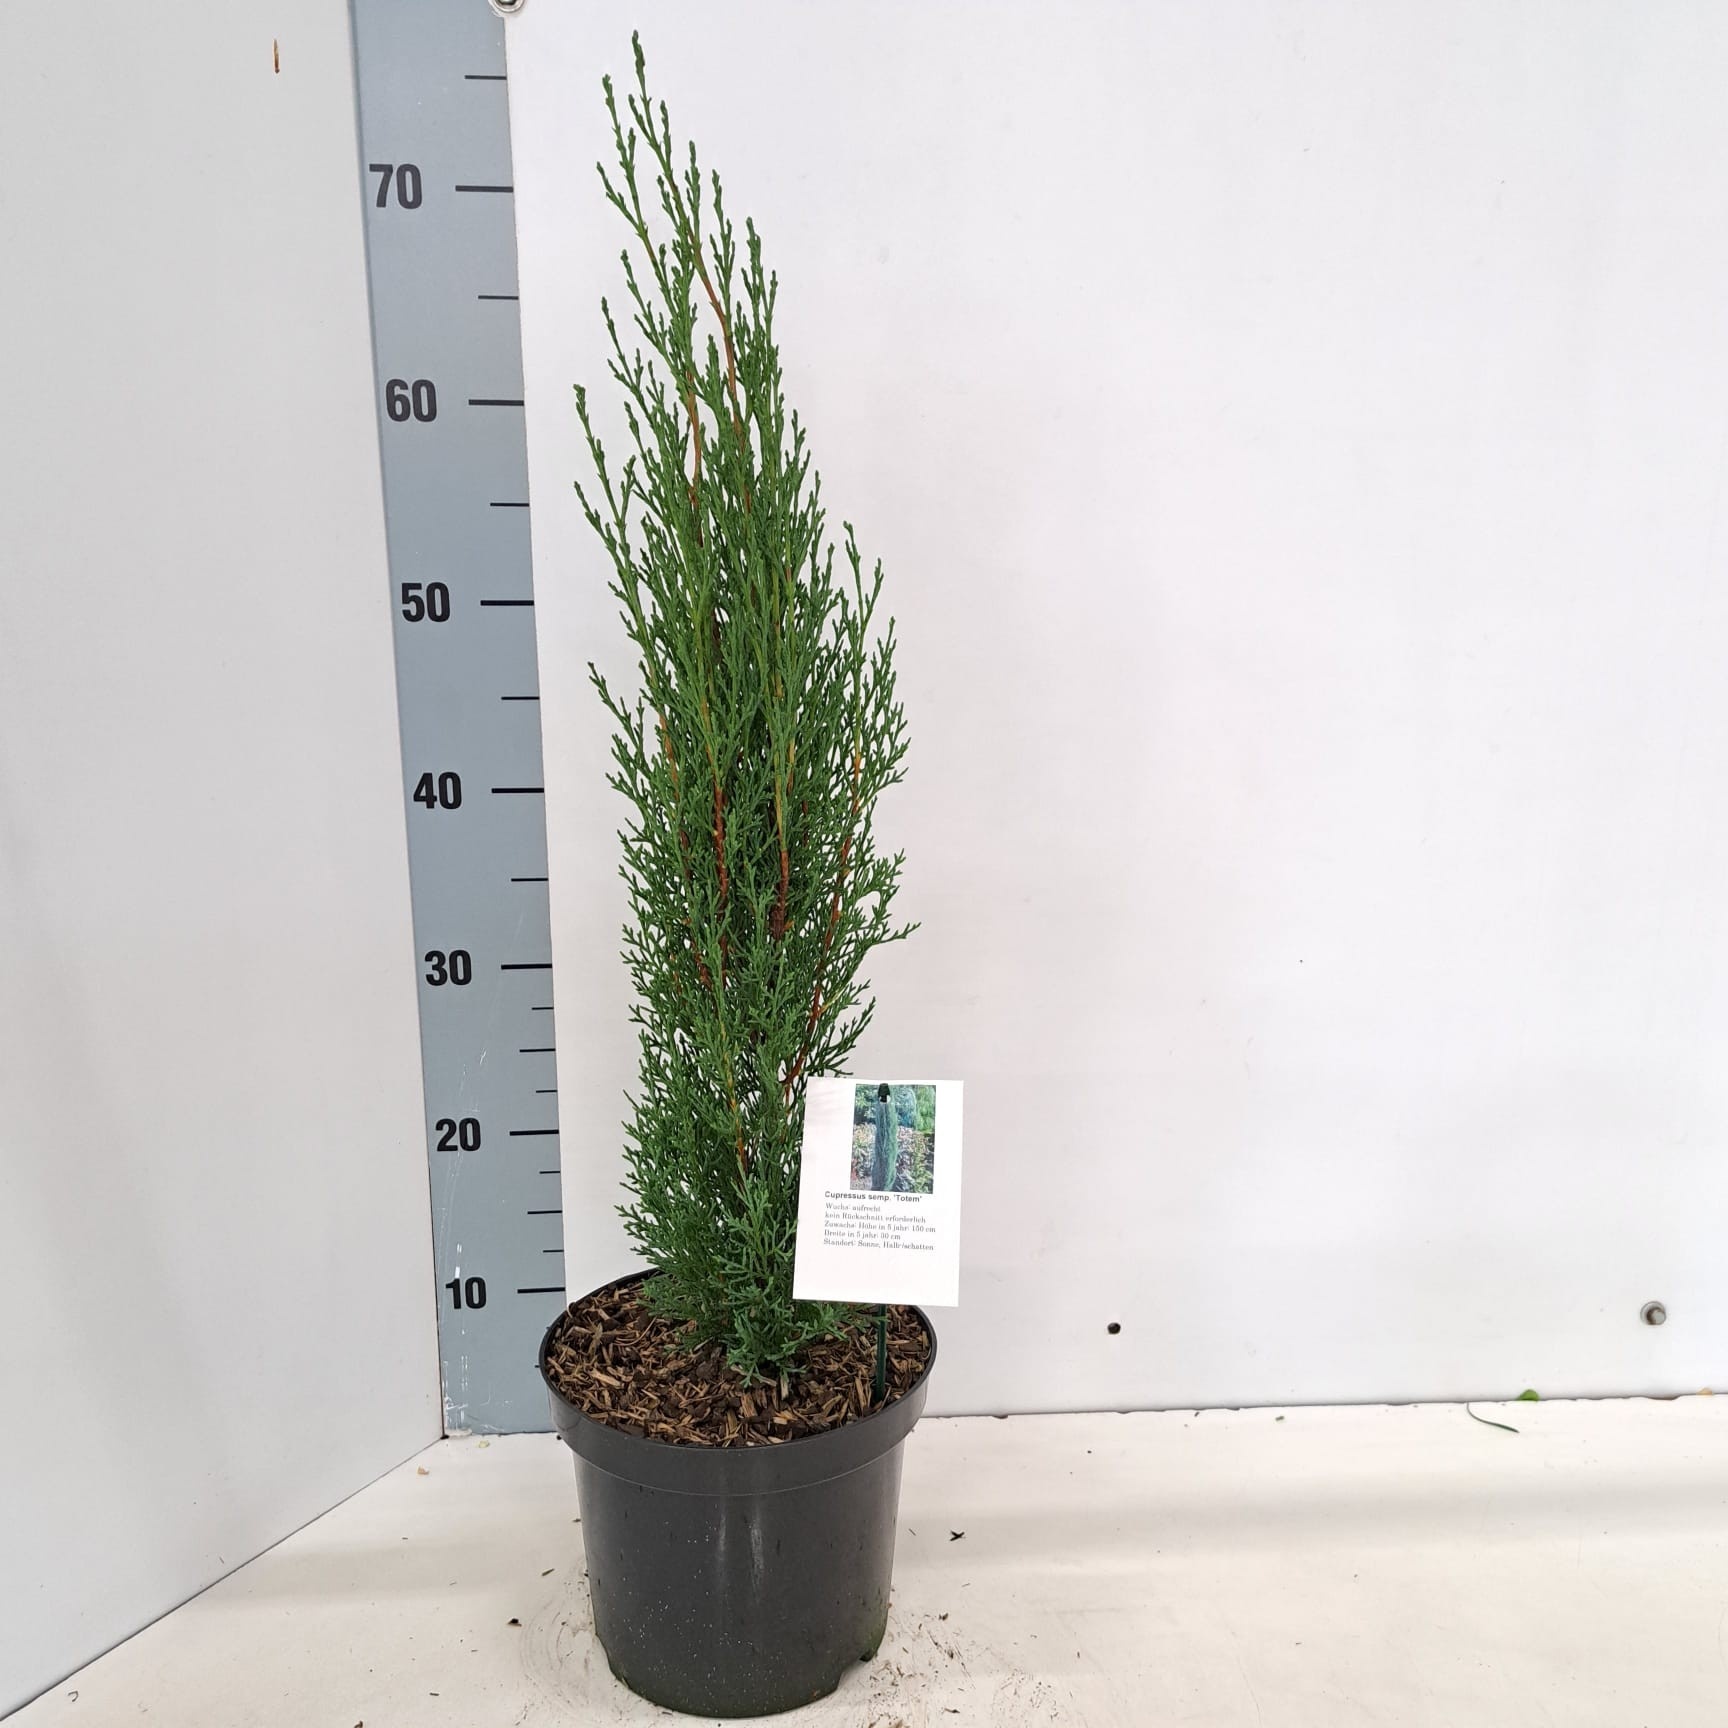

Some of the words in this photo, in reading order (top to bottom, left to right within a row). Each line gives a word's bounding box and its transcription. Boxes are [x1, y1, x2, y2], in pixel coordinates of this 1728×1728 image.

[370, 165, 421, 208] 70
[386, 380, 436, 421] 60
[402, 583, 450, 622] 50
[414, 772, 461, 809] 40
[425, 950, 471, 986] 30
[436, 1118, 481, 1151] 20
[825, 1191, 866, 1200] Cupressus
[868, 1194, 891, 1202] semp.
[446, 1278, 486, 1309] 10
